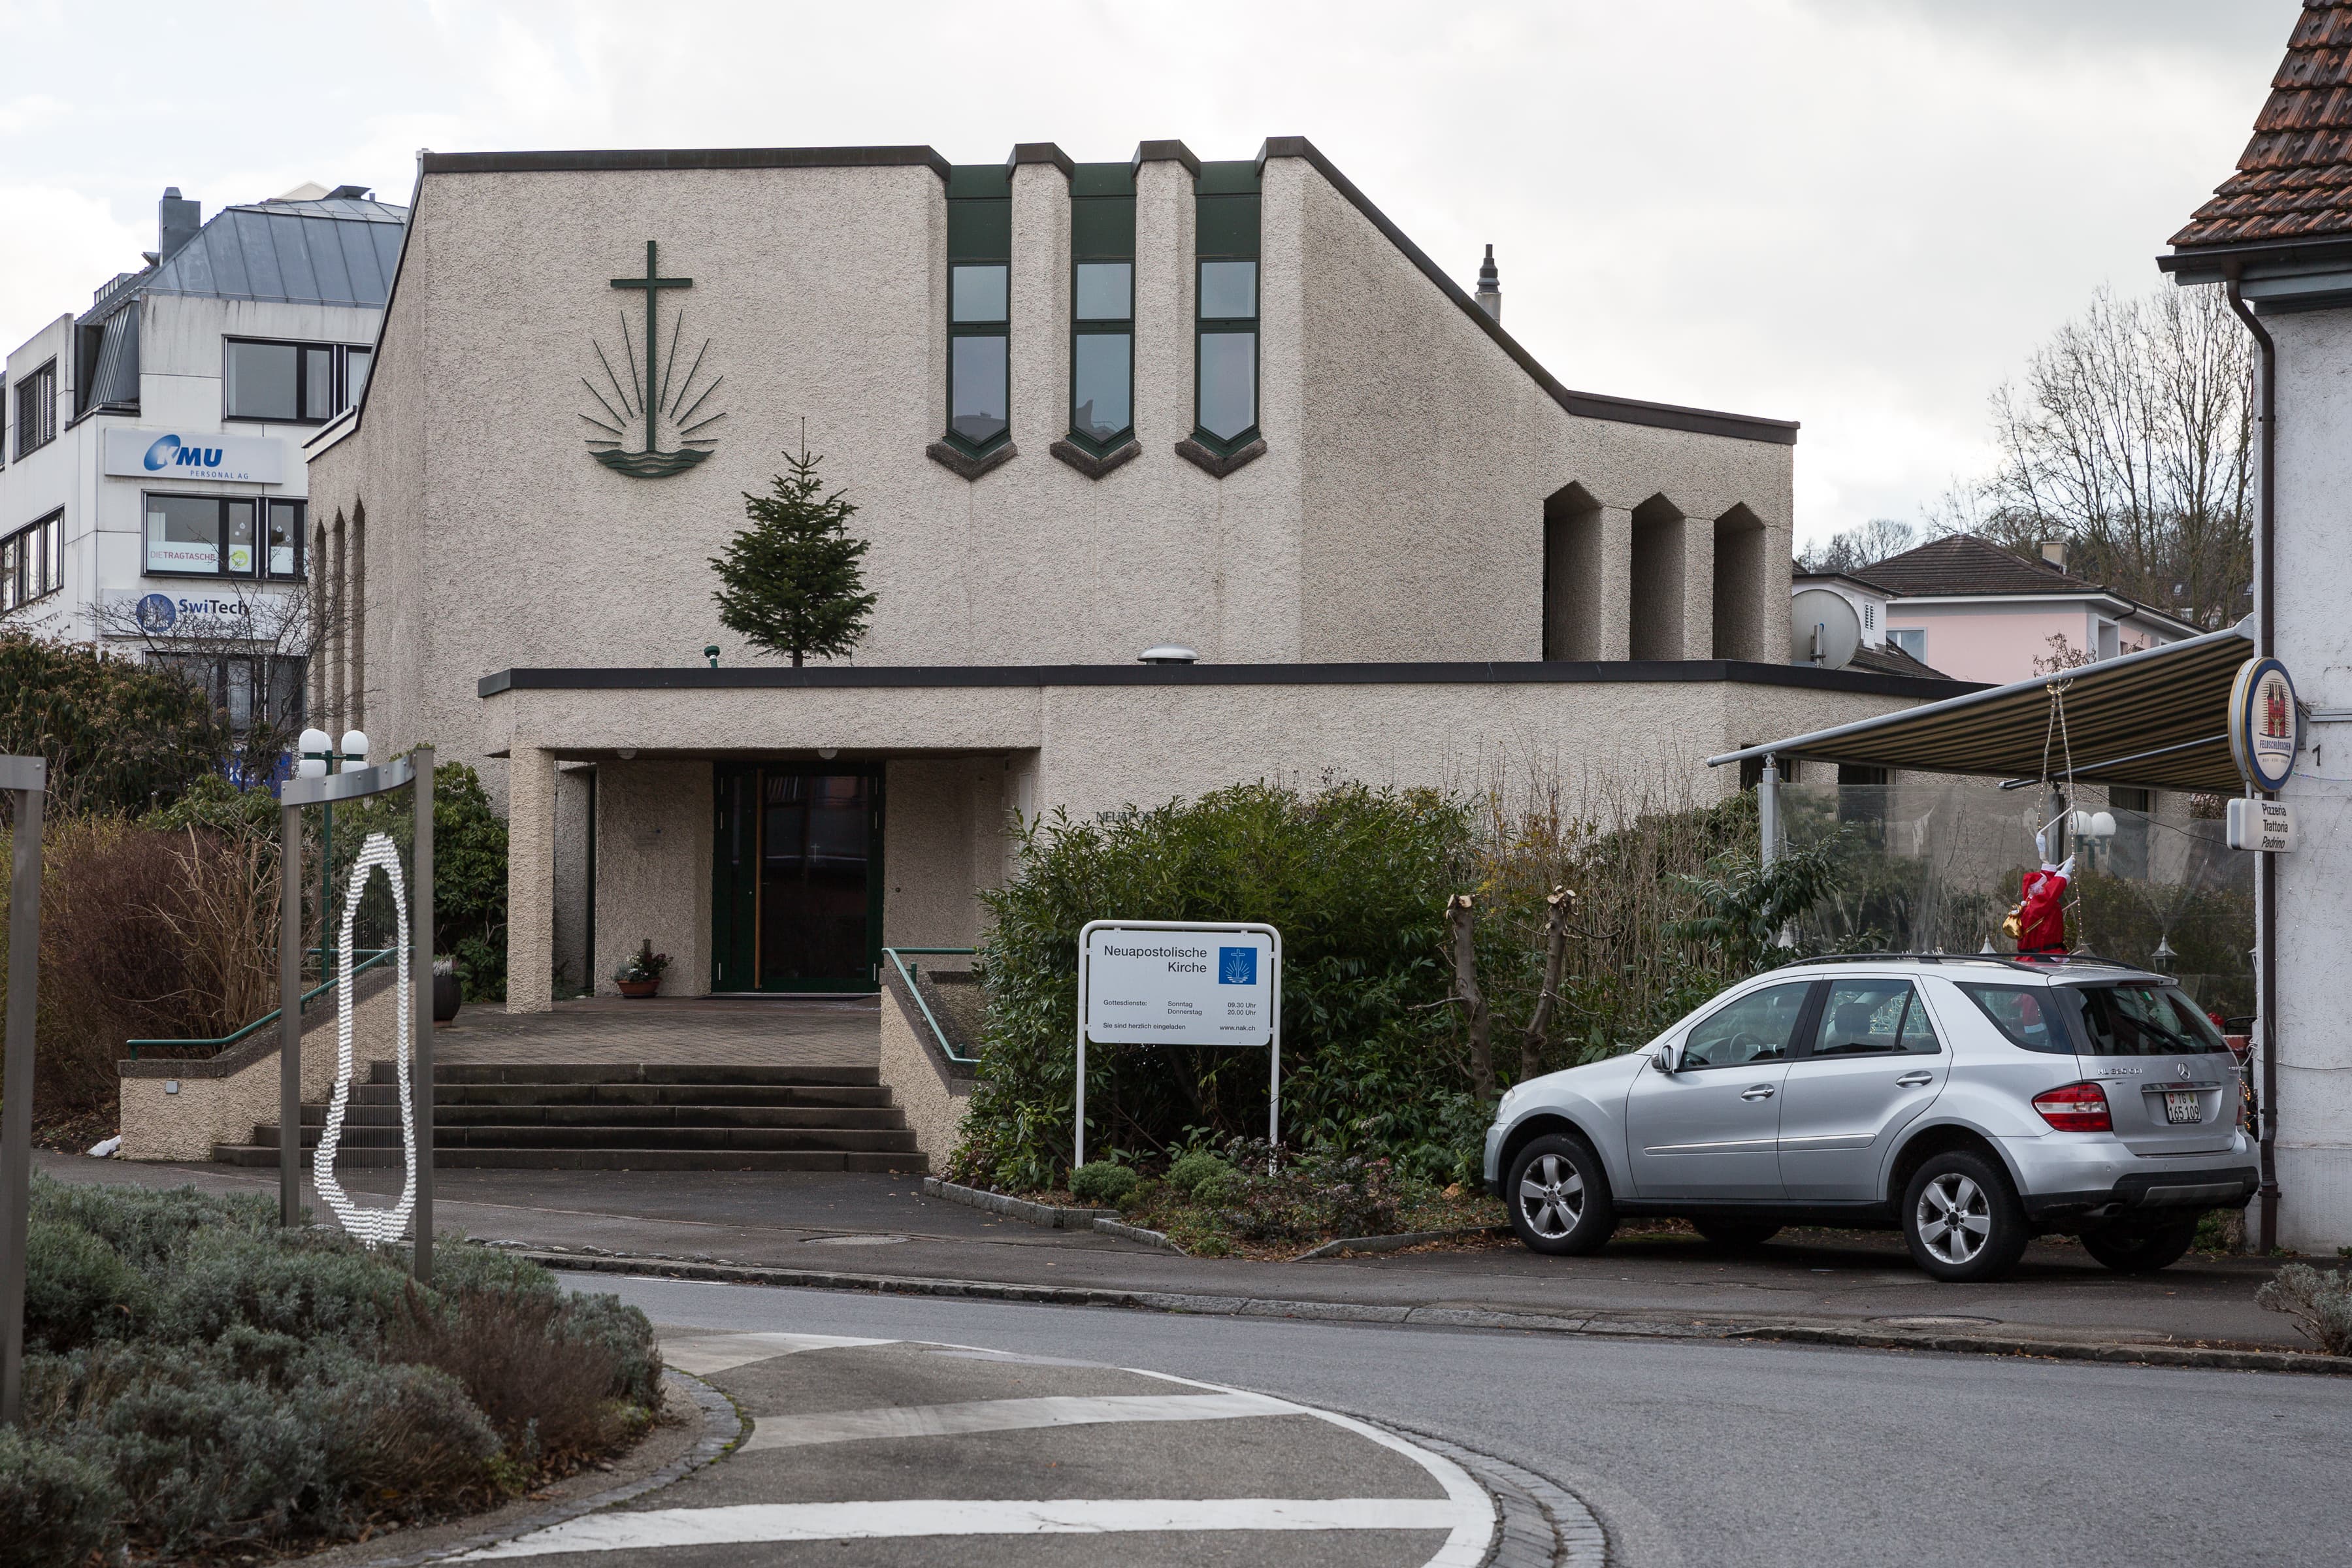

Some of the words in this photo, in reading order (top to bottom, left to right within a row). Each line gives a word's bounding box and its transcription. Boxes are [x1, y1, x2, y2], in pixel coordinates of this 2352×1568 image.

[156, 445, 223, 467] KMU
[190, 470, 234, 479] PERSONAL
[178, 598, 248, 614] SwiTech
[2261, 803, 2287, 817] Pizzeria
[2262, 819, 2289, 833] Trattoria
[2261, 836, 2285, 849] Padrino
[1104, 945, 1207, 959] Neuapostolische
[1168, 961, 1207, 973] Kirche
[1167, 1008, 1203, 1017] Donnerstag
[2177, 1092, 2187, 1104] TG
[2168, 1105, 2184, 1120] 165
[2184, 1105, 2199, 1120] 109
